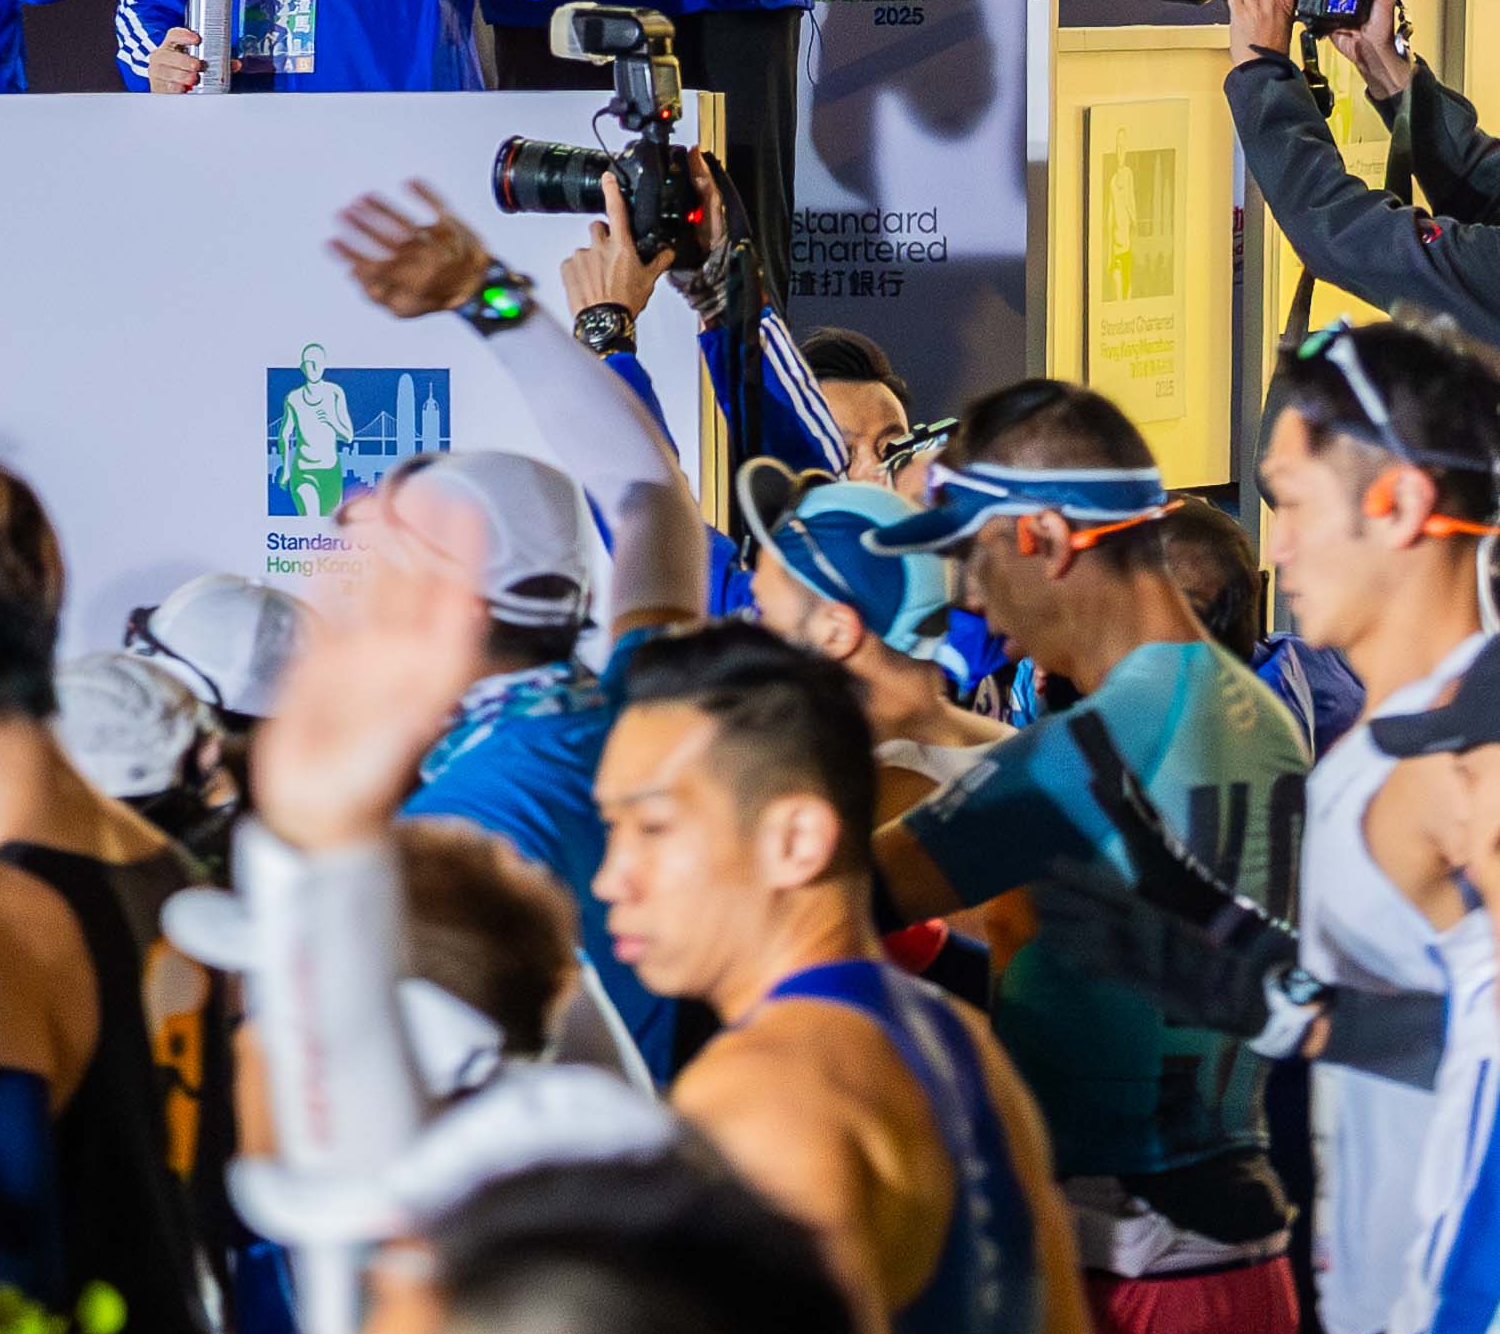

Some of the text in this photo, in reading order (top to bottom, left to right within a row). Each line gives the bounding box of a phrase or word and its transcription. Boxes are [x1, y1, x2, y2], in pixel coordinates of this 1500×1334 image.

[874, 6, 925, 26] 2025
[792, 206, 939, 235] standard
[790, 236, 949, 265] chartered
[790, 270, 905, 298] 渣打銀行
[267, 556, 314, 577] Hong
